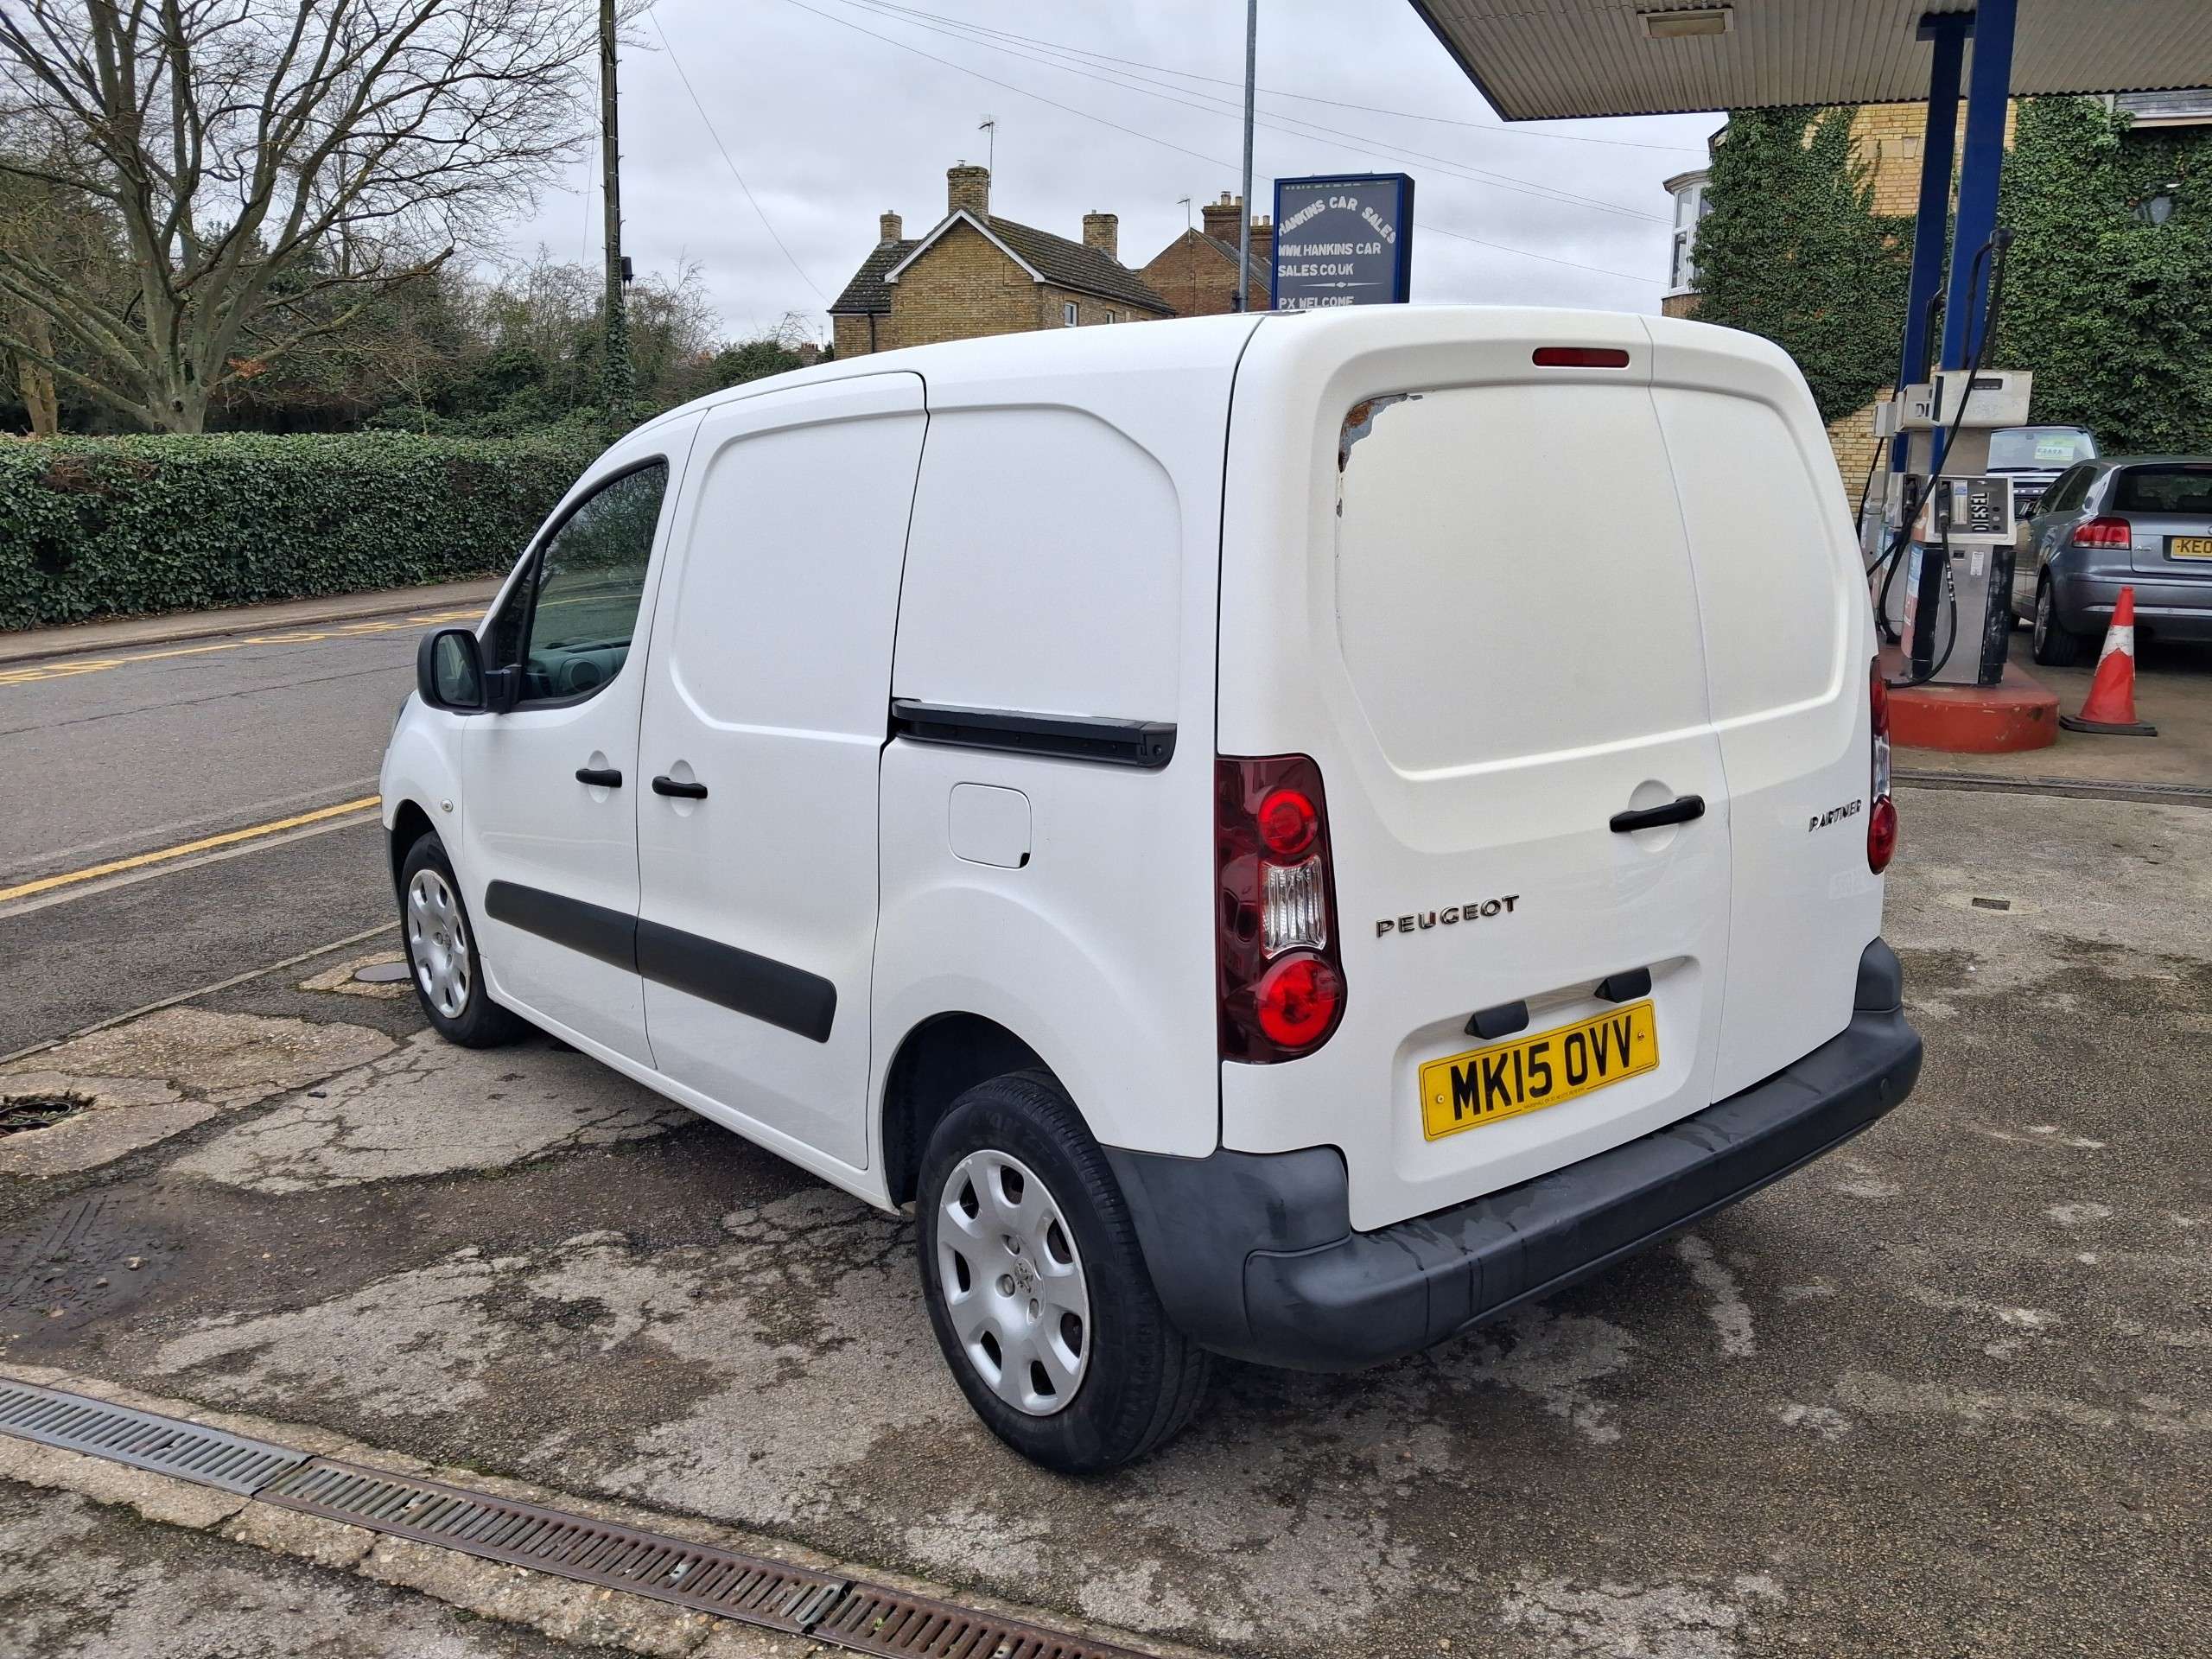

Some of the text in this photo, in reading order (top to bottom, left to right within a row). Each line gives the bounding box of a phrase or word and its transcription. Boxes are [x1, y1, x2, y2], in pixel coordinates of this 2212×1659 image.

[1279, 196, 1396, 244] HANKINS CAR SALES
[1356, 242, 1382, 255] CAR
[1278, 264, 1354, 277] SALES.CO.UK
[1279, 296, 1355, 309] PX WELCOME
[1971, 493, 1989, 532] DIESEL
[1808, 799, 1862, 832] PARTNER
[1376, 893, 1520, 938] PEUGEOT
[1450, 1015, 1632, 1122] MK15 OVV
